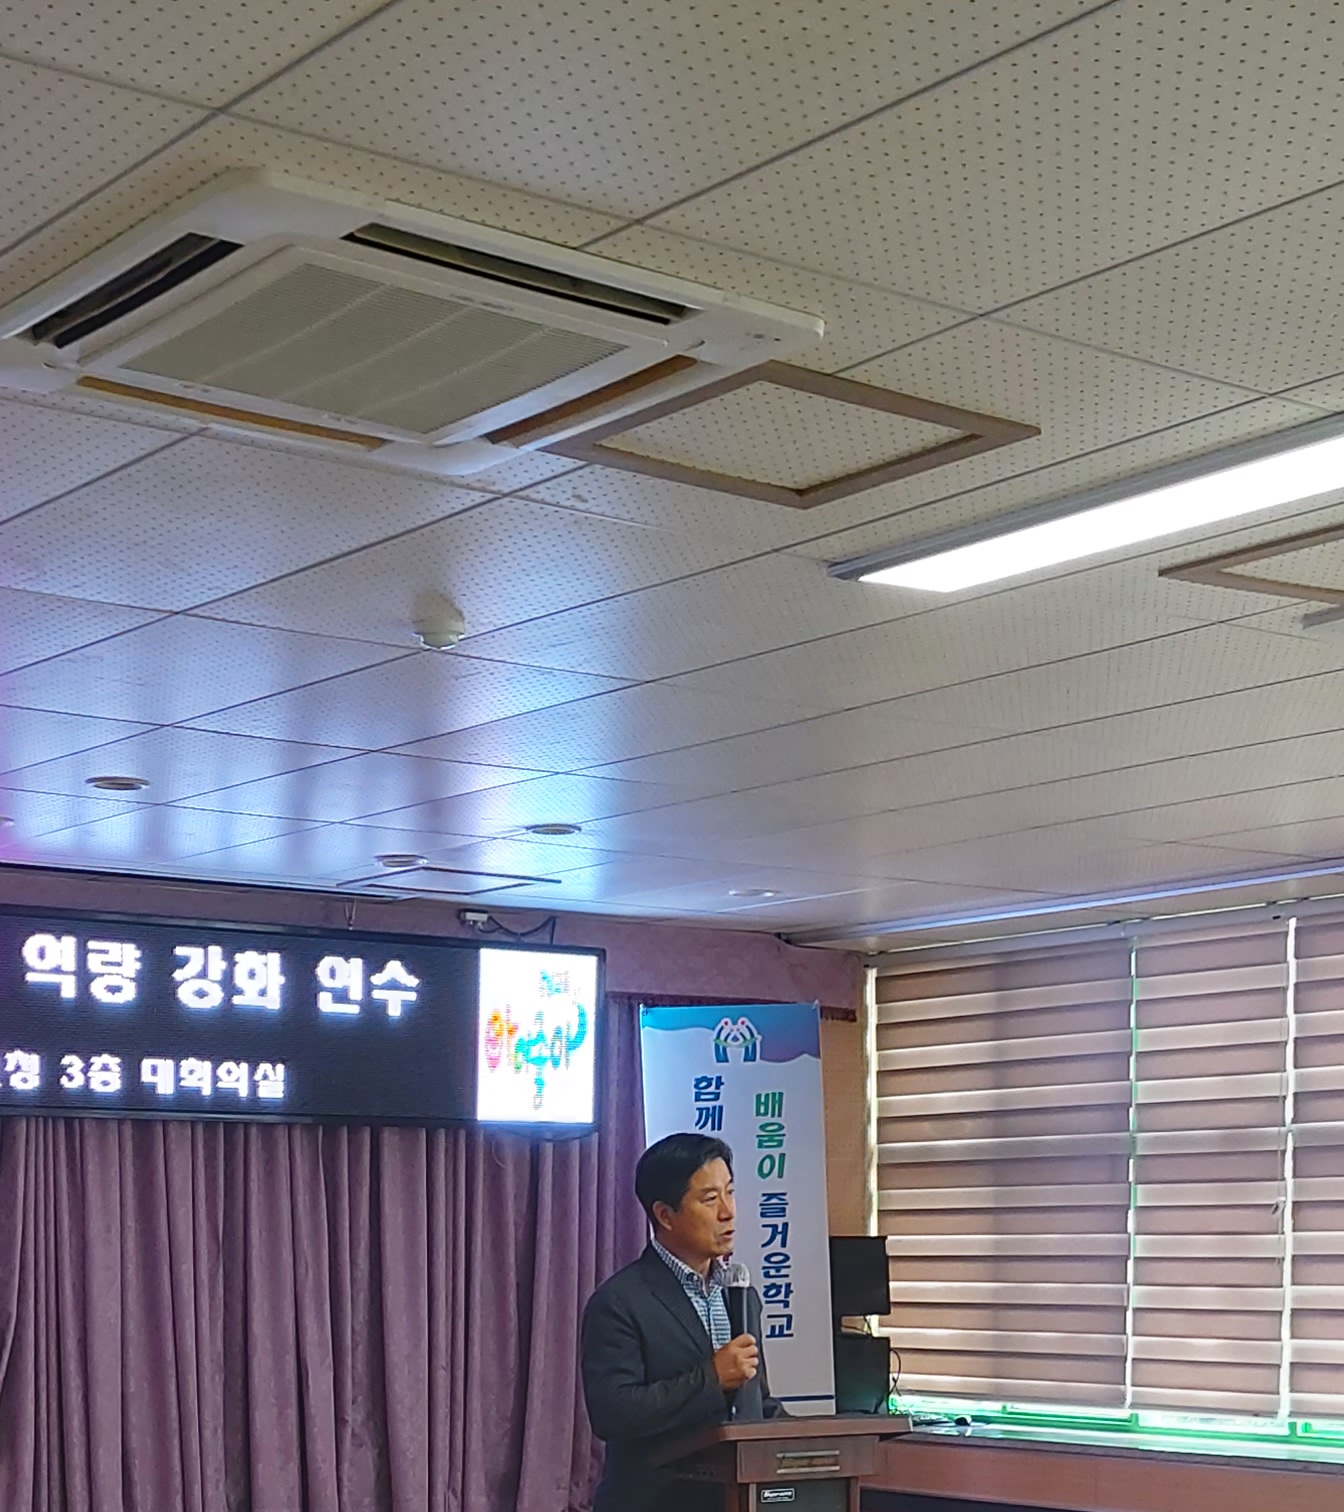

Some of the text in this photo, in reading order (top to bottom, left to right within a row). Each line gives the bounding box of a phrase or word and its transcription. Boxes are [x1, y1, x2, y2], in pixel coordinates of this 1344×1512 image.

[21, 933, 144, 1006] 역량
[171, 945, 288, 1012] 강화
[315, 955, 422, 1019] 연수
[59, 1053, 123, 1094] 3층
[140, 1056, 288, 1101] 대회의실
[693, 1074, 725, 1132] 함께
[754, 1090, 786, 1180] 배움이
